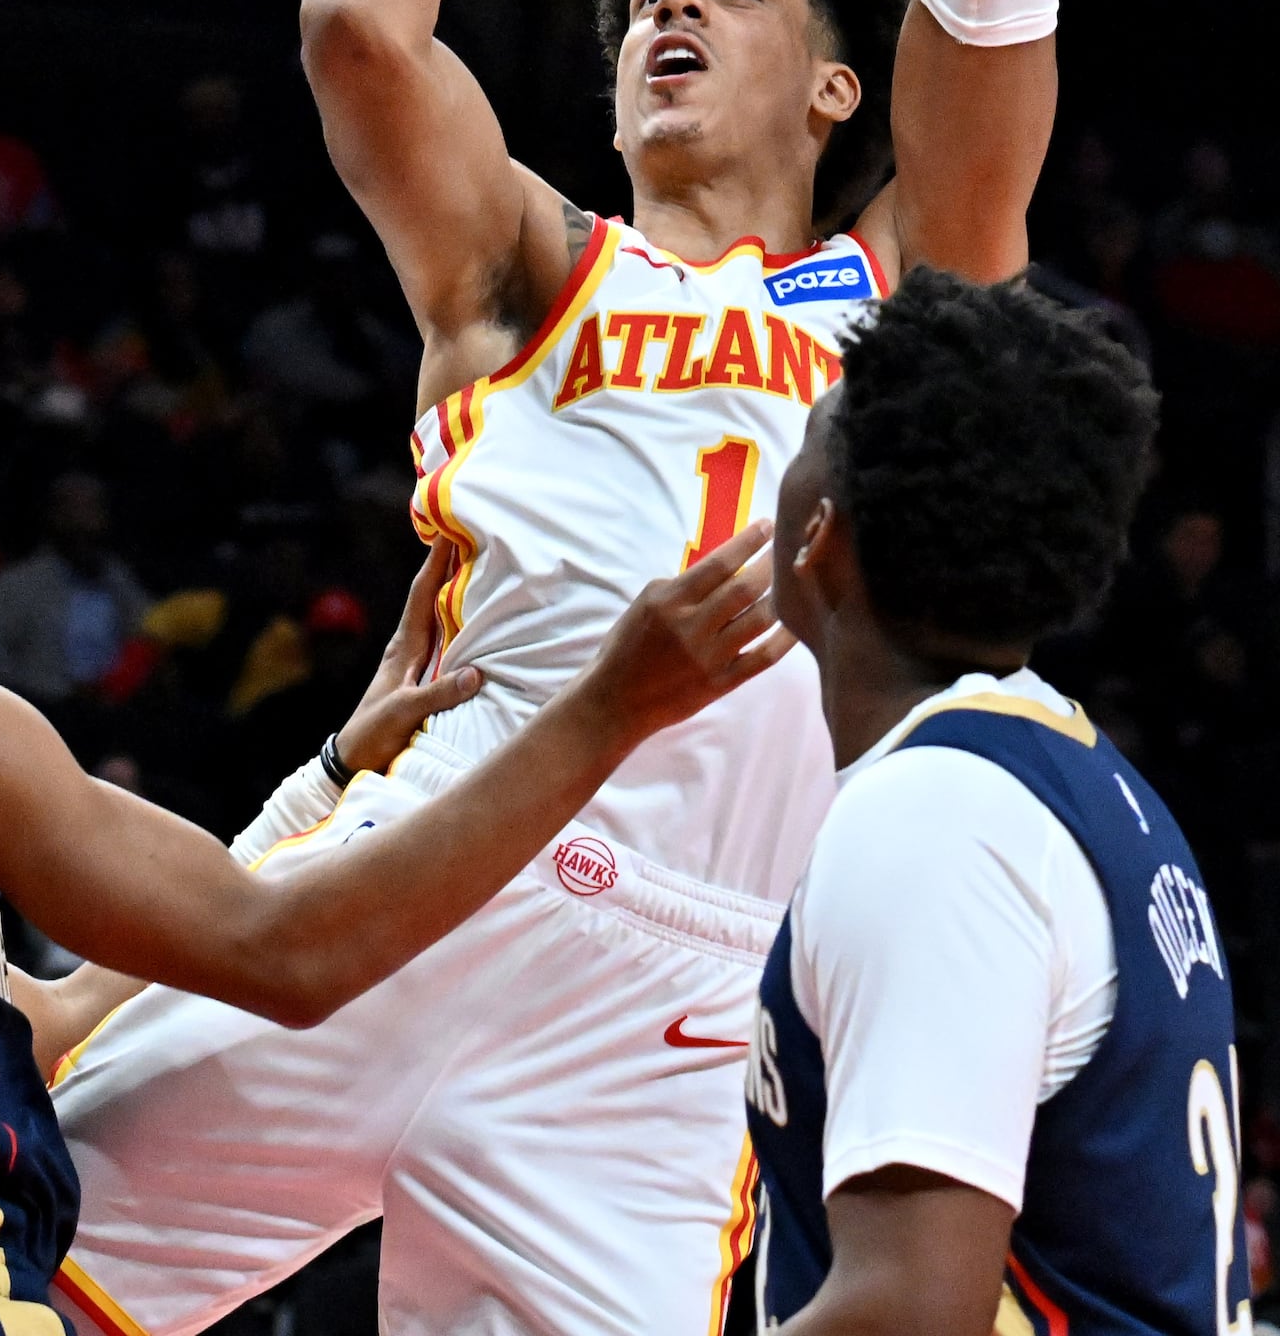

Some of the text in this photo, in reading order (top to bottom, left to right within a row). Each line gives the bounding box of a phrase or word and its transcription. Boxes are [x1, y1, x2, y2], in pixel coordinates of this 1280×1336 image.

[772, 267, 860, 299] paze
[679, 433, 761, 576] 1
[552, 842, 619, 888] HAWKS
[1187, 1043, 1253, 1336] 2
